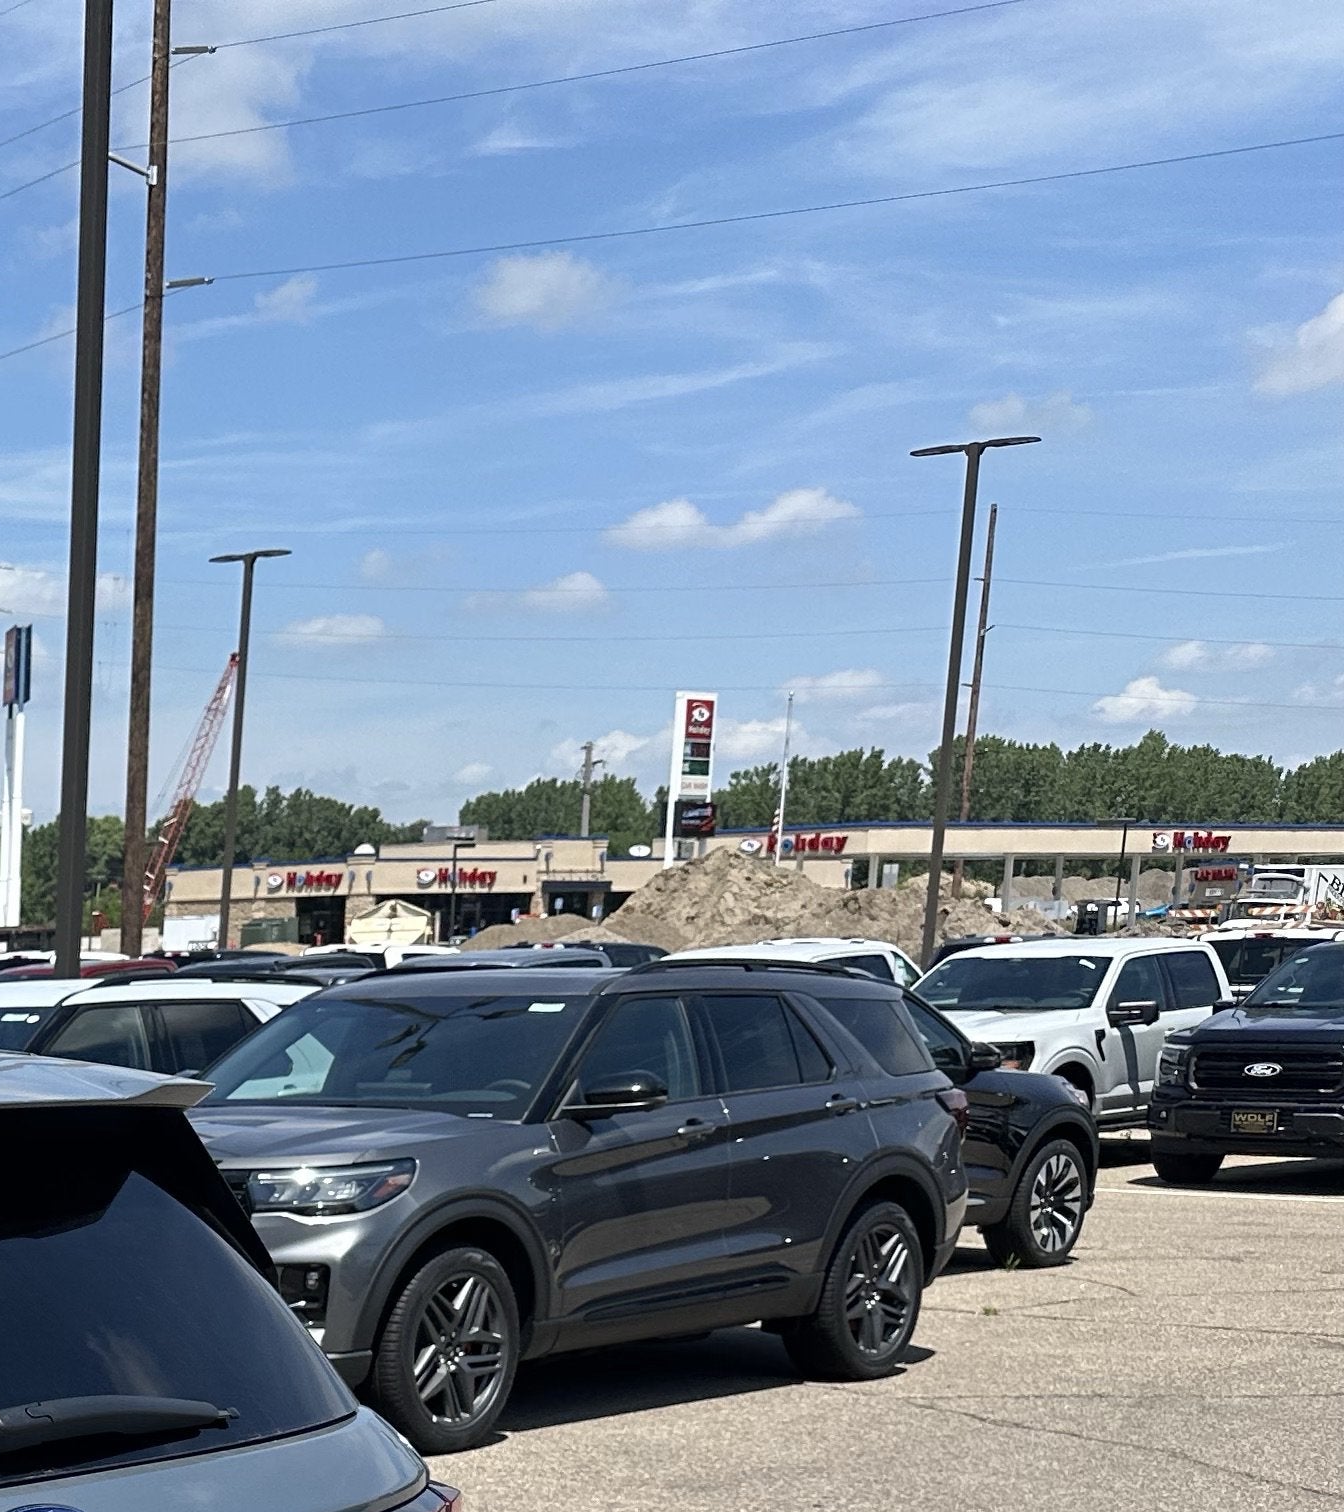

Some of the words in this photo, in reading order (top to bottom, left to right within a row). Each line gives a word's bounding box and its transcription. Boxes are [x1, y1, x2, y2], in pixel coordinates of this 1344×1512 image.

[1172, 831, 1232, 853] Holiday
[286, 871, 343, 888] Holiday
[1234, 1113, 1274, 1121] WOLF
